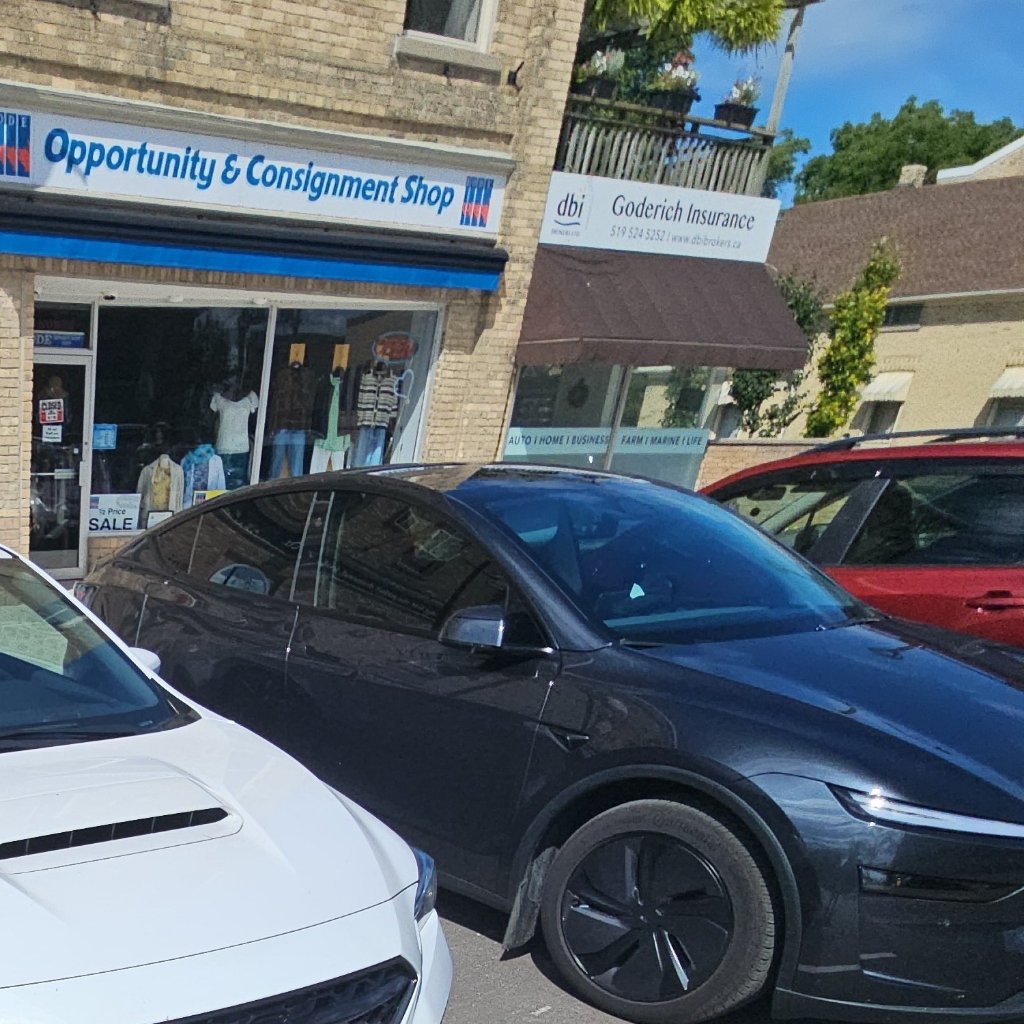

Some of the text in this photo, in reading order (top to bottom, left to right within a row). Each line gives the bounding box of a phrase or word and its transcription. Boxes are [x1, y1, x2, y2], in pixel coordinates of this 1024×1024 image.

[44, 128, 455, 214] Opportunity & Consignment Shop
[557, 192, 585, 218] dbi
[612, 194, 756, 231] Goderich Insurance
[610, 225, 626, 237] 519
[628, 228, 643, 239] 524
[645, 229, 666, 241] 5252
[671, 234, 742, 249] www.dbibrokers.ca
[34, 333, 53, 346] DE
[509, 435, 532, 445] AUTO
[539, 434, 563, 445] HOME
[572, 434, 610, 445] BUSINESS
[687, 436, 703, 446] LIFE
[88, 517, 133, 531] SALE
